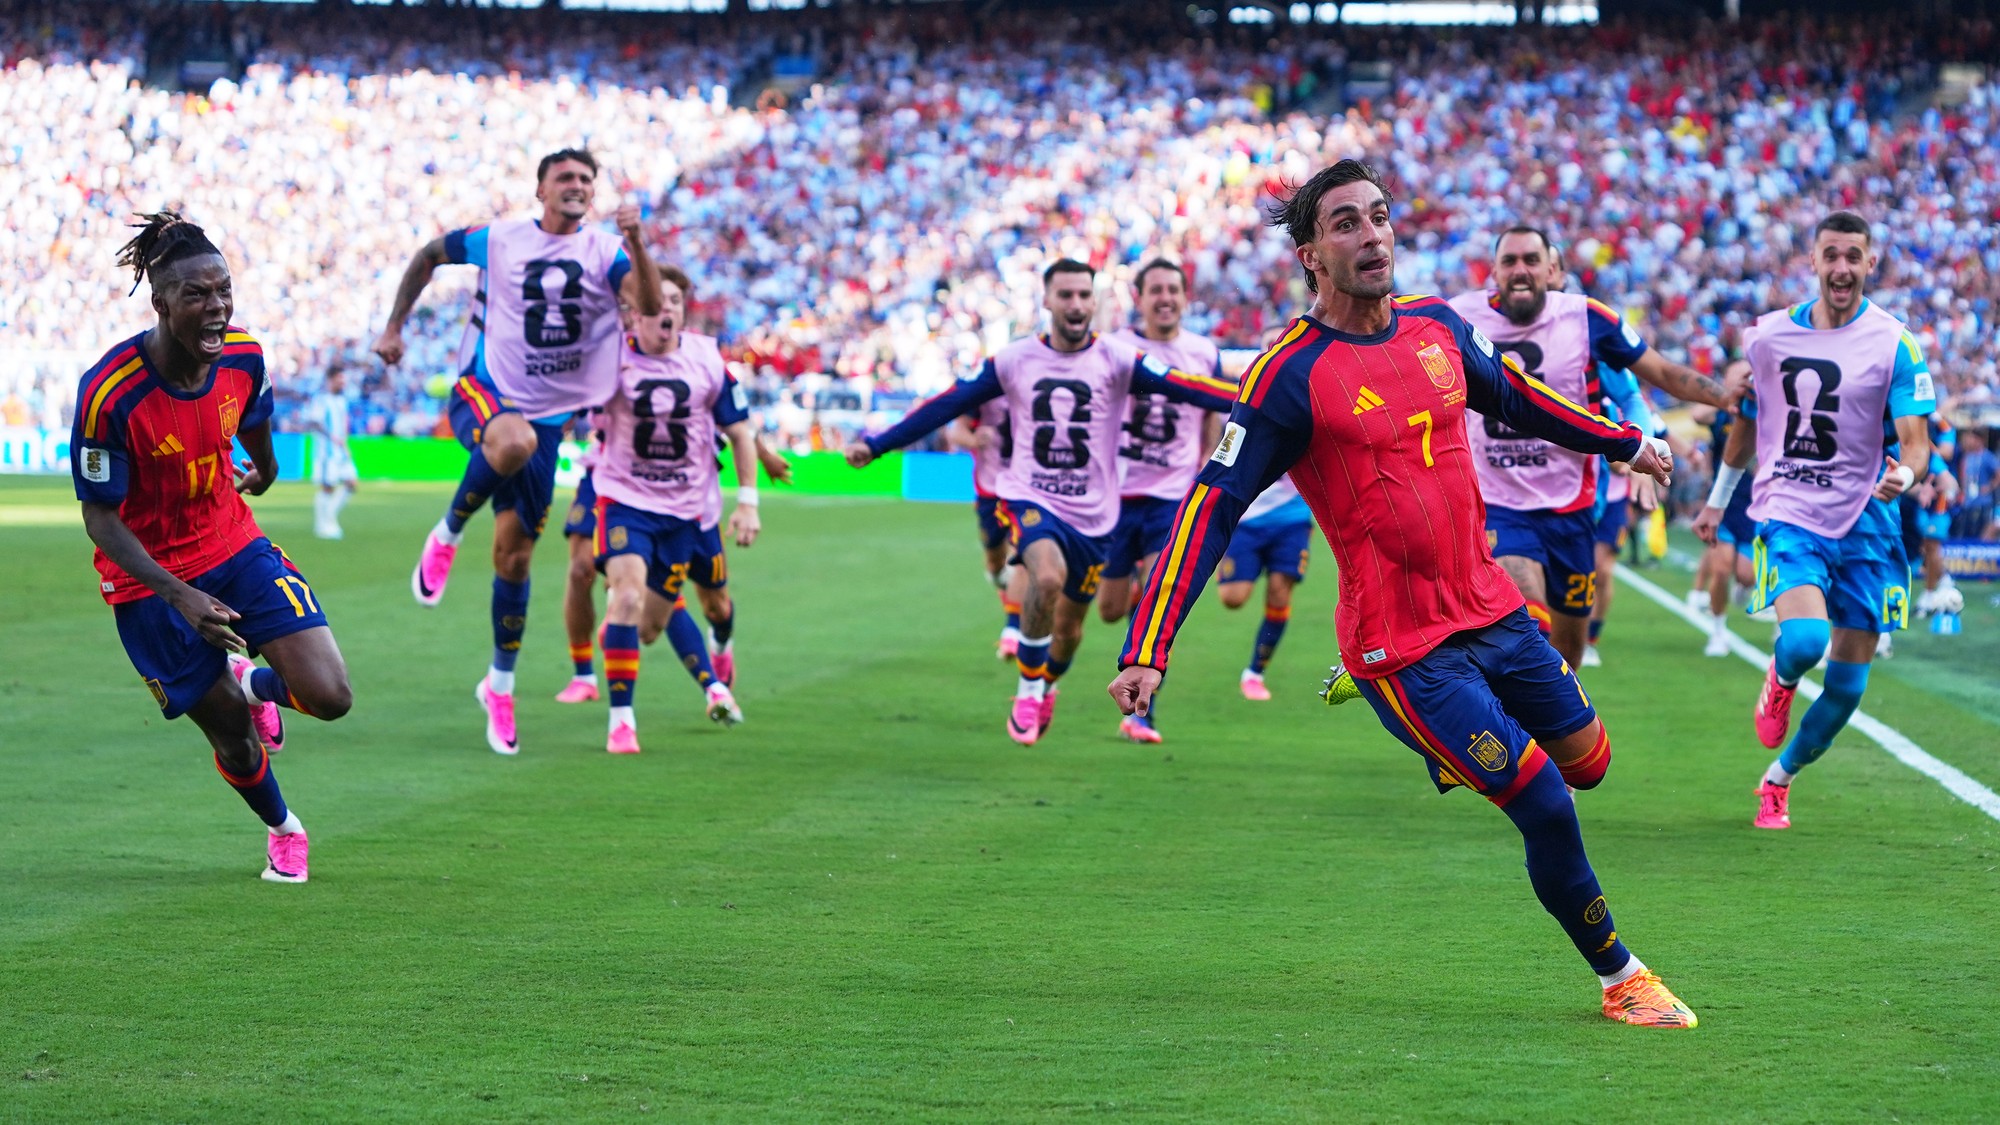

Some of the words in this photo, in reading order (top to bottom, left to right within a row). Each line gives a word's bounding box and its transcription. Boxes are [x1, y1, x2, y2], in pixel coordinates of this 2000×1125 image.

[541, 328, 570, 341] FIFA
[1407, 409, 1434, 468] 7
[1485, 445, 1523, 453] WORLD
[1790, 439, 1820, 454] FIFA
[1487, 455, 1547, 468] 2026
[187, 451, 218, 499] 17
[274, 575, 318, 617] 17
